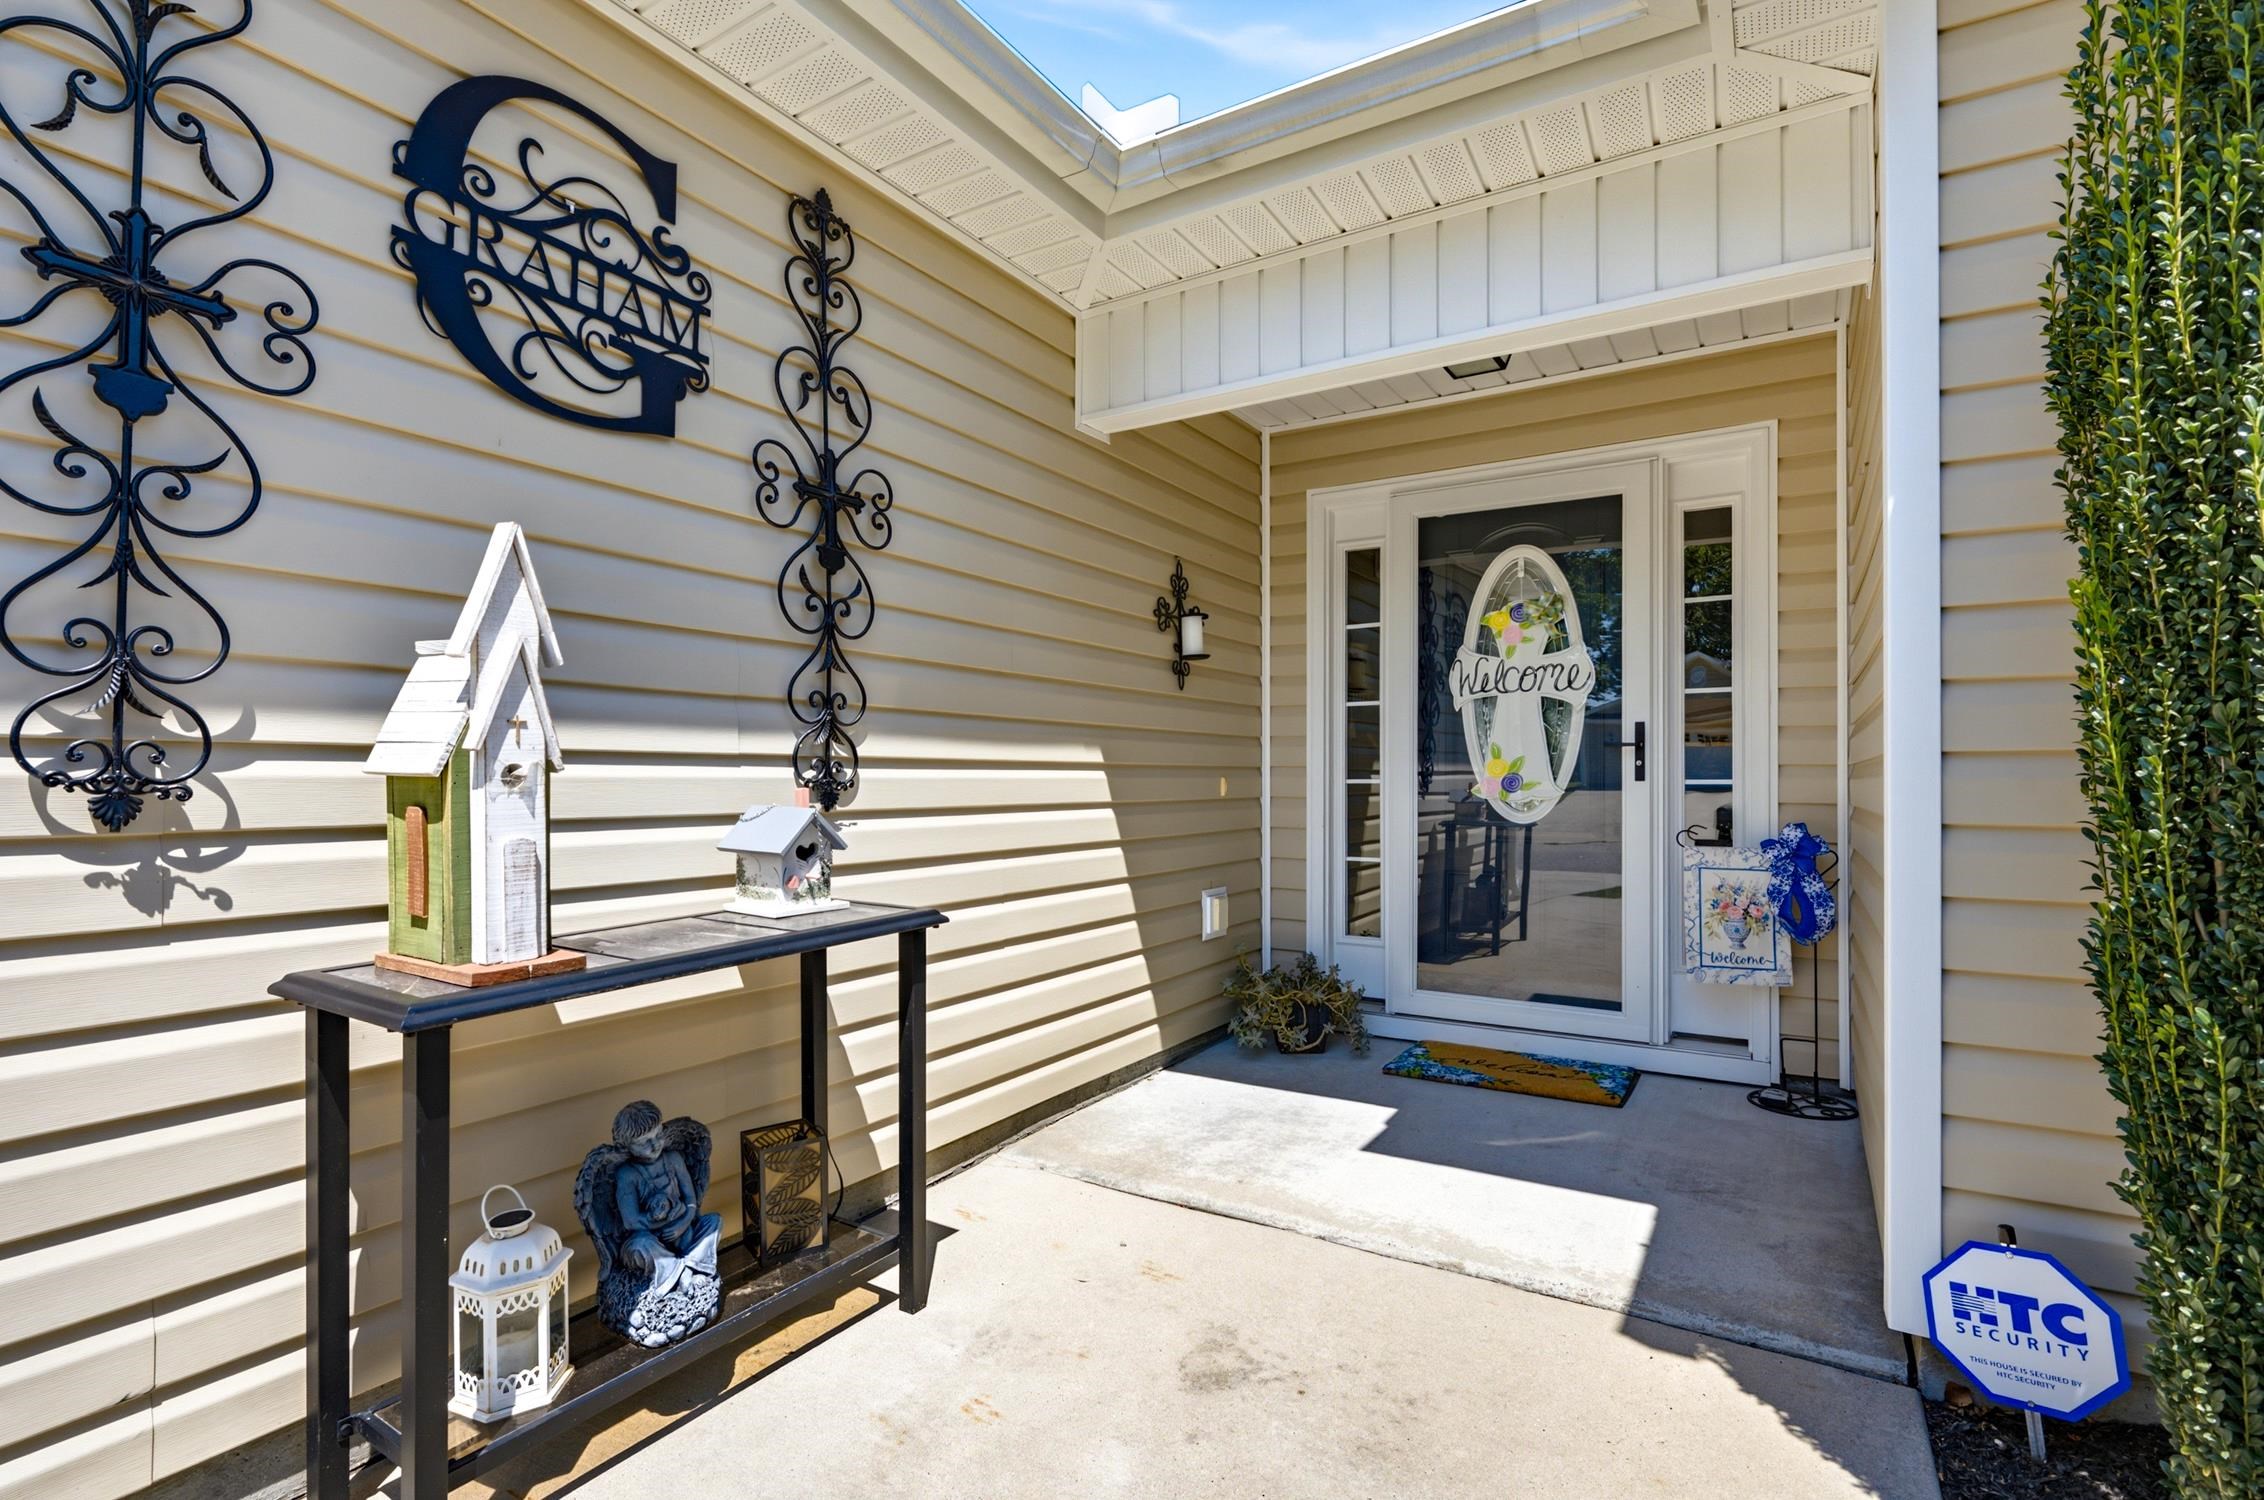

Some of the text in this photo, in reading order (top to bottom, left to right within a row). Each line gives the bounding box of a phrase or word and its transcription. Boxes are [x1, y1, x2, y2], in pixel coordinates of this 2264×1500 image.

[393, 75, 703, 437] G
[404, 186, 711, 365] GRAHAM
[1451, 657, 1593, 697] Welcome
[1949, 1281, 2088, 1346] HTC
[1956, 1321, 2090, 1362] SECURITY
[1969, 1355, 2083, 1388] THIS HOUSE IS SECURED BY
[1996, 1370, 2056, 1390] HTC SECURITY
